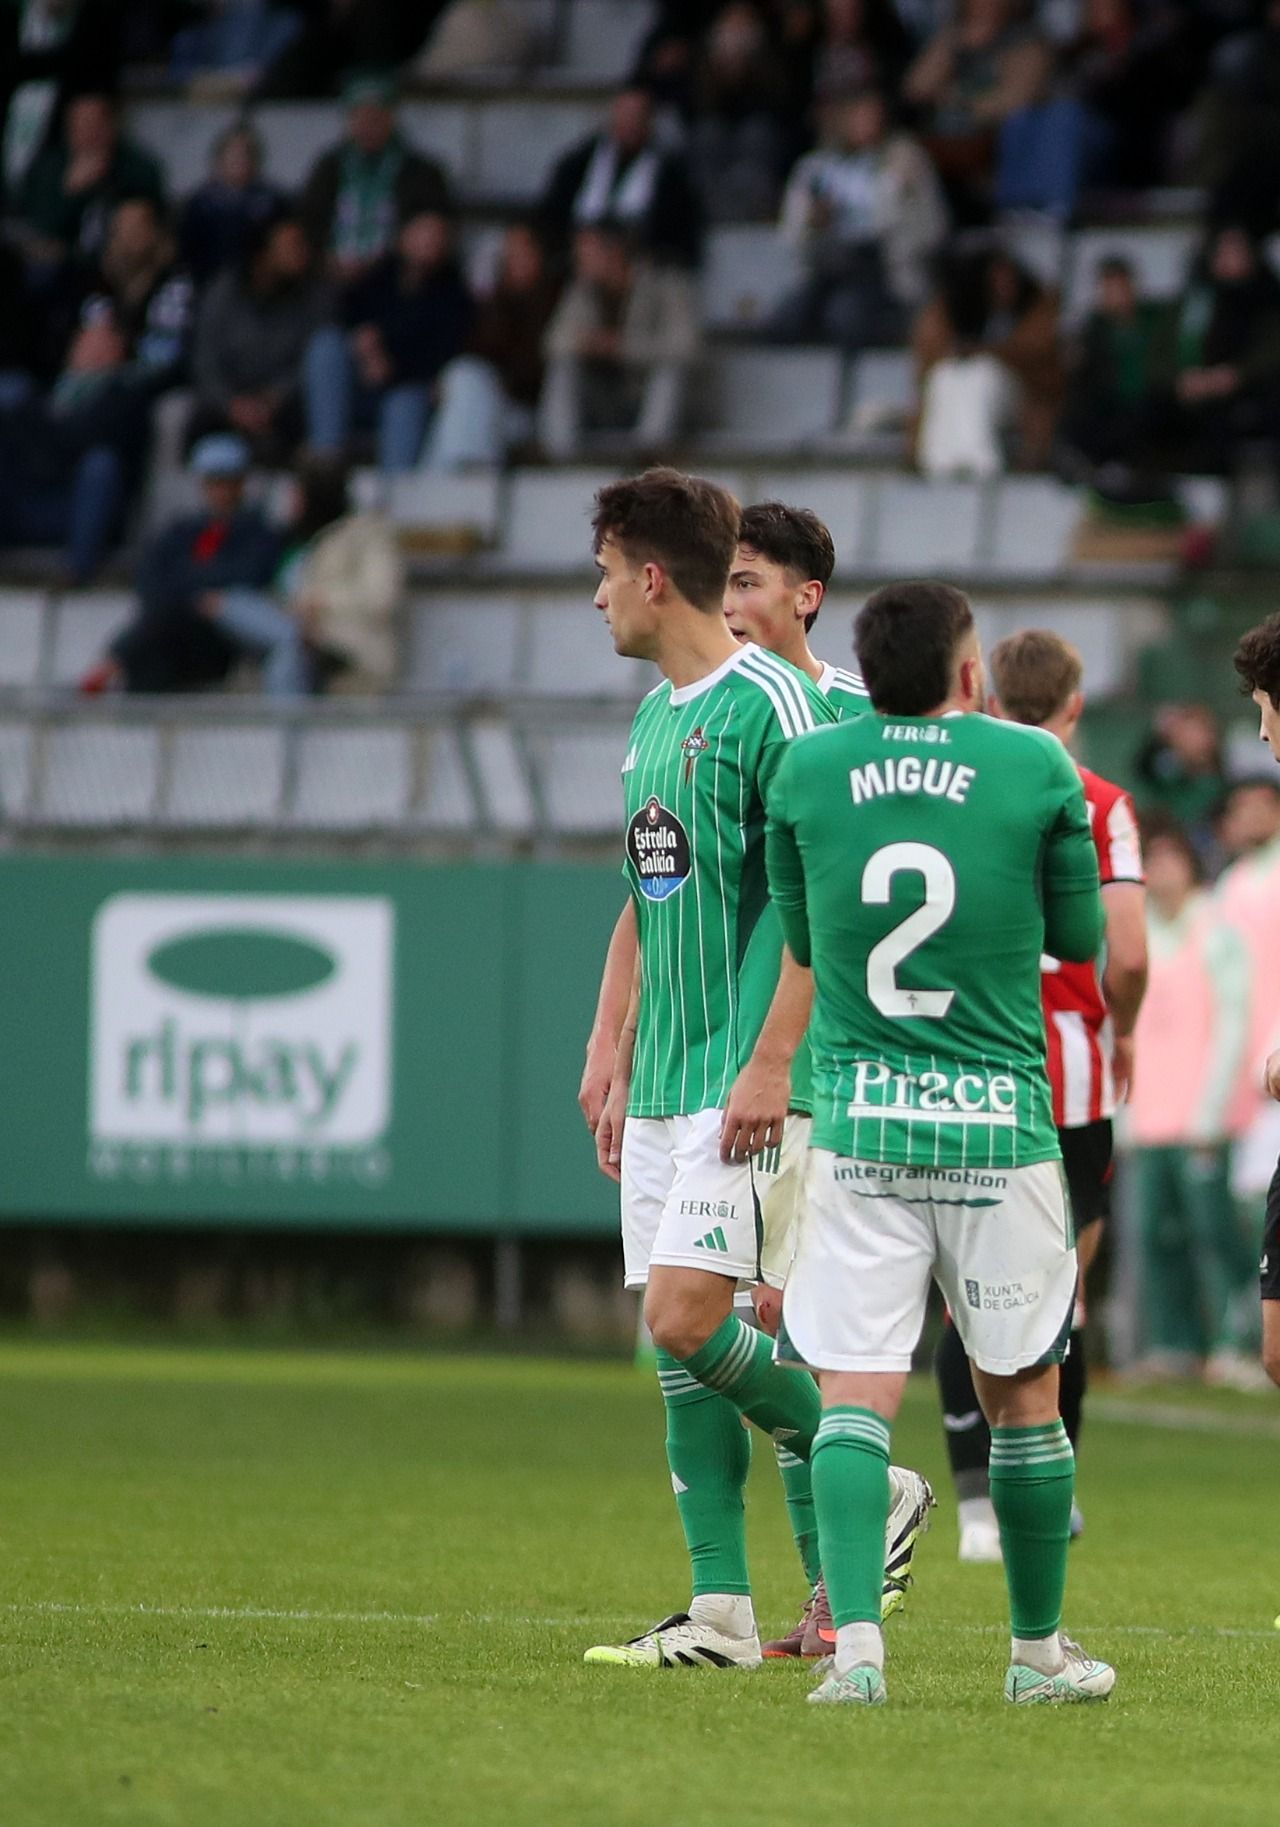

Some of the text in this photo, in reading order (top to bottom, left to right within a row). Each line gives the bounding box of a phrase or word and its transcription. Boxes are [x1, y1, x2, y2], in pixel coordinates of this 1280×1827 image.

[849, 757, 976, 804] MIGUE
[861, 841, 957, 1019] 2
[850, 1061, 1018, 1113] Prace
[833, 1164, 1008, 1189] integralmotion
[983, 1282, 1024, 1298] XUNTA
[983, 1298, 1001, 1311] DE
